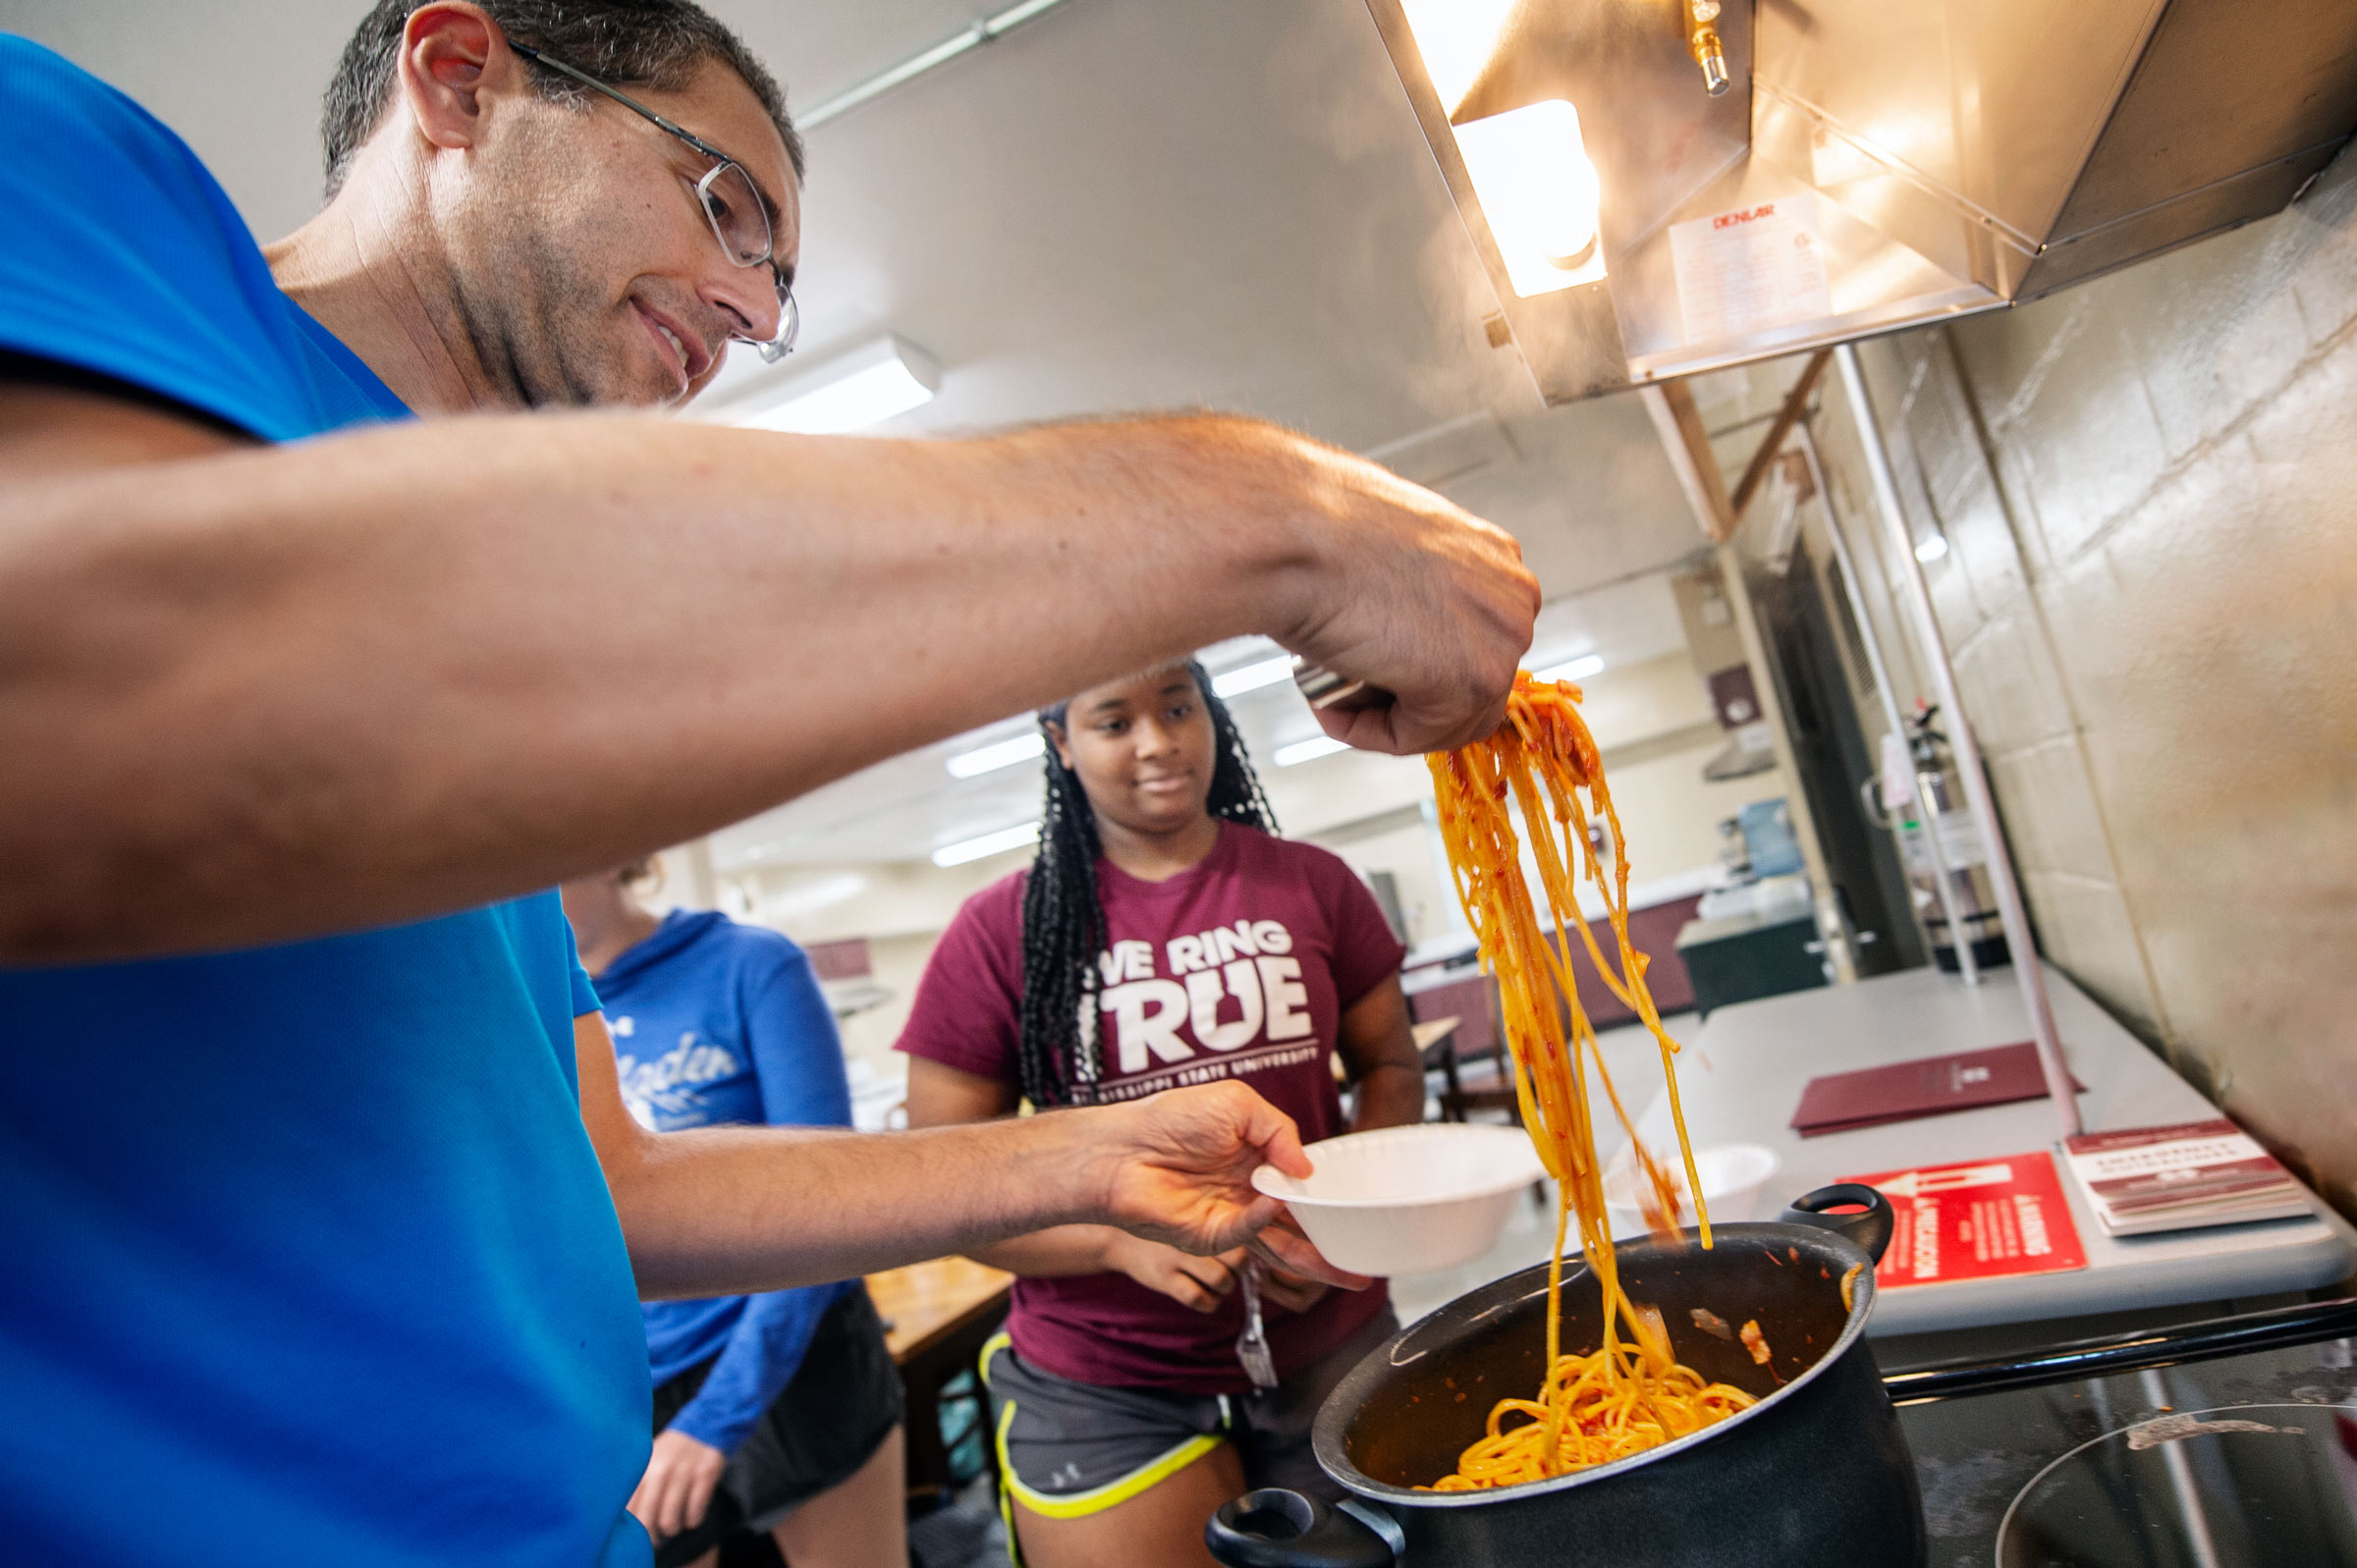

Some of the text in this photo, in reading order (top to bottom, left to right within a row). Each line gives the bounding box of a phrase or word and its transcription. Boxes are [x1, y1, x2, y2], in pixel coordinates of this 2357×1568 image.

[1166, 919, 1292, 976] RING
[1178, 1063, 1227, 1087] STATE
[1231, 1047, 1318, 1076] UNIVERSITY
